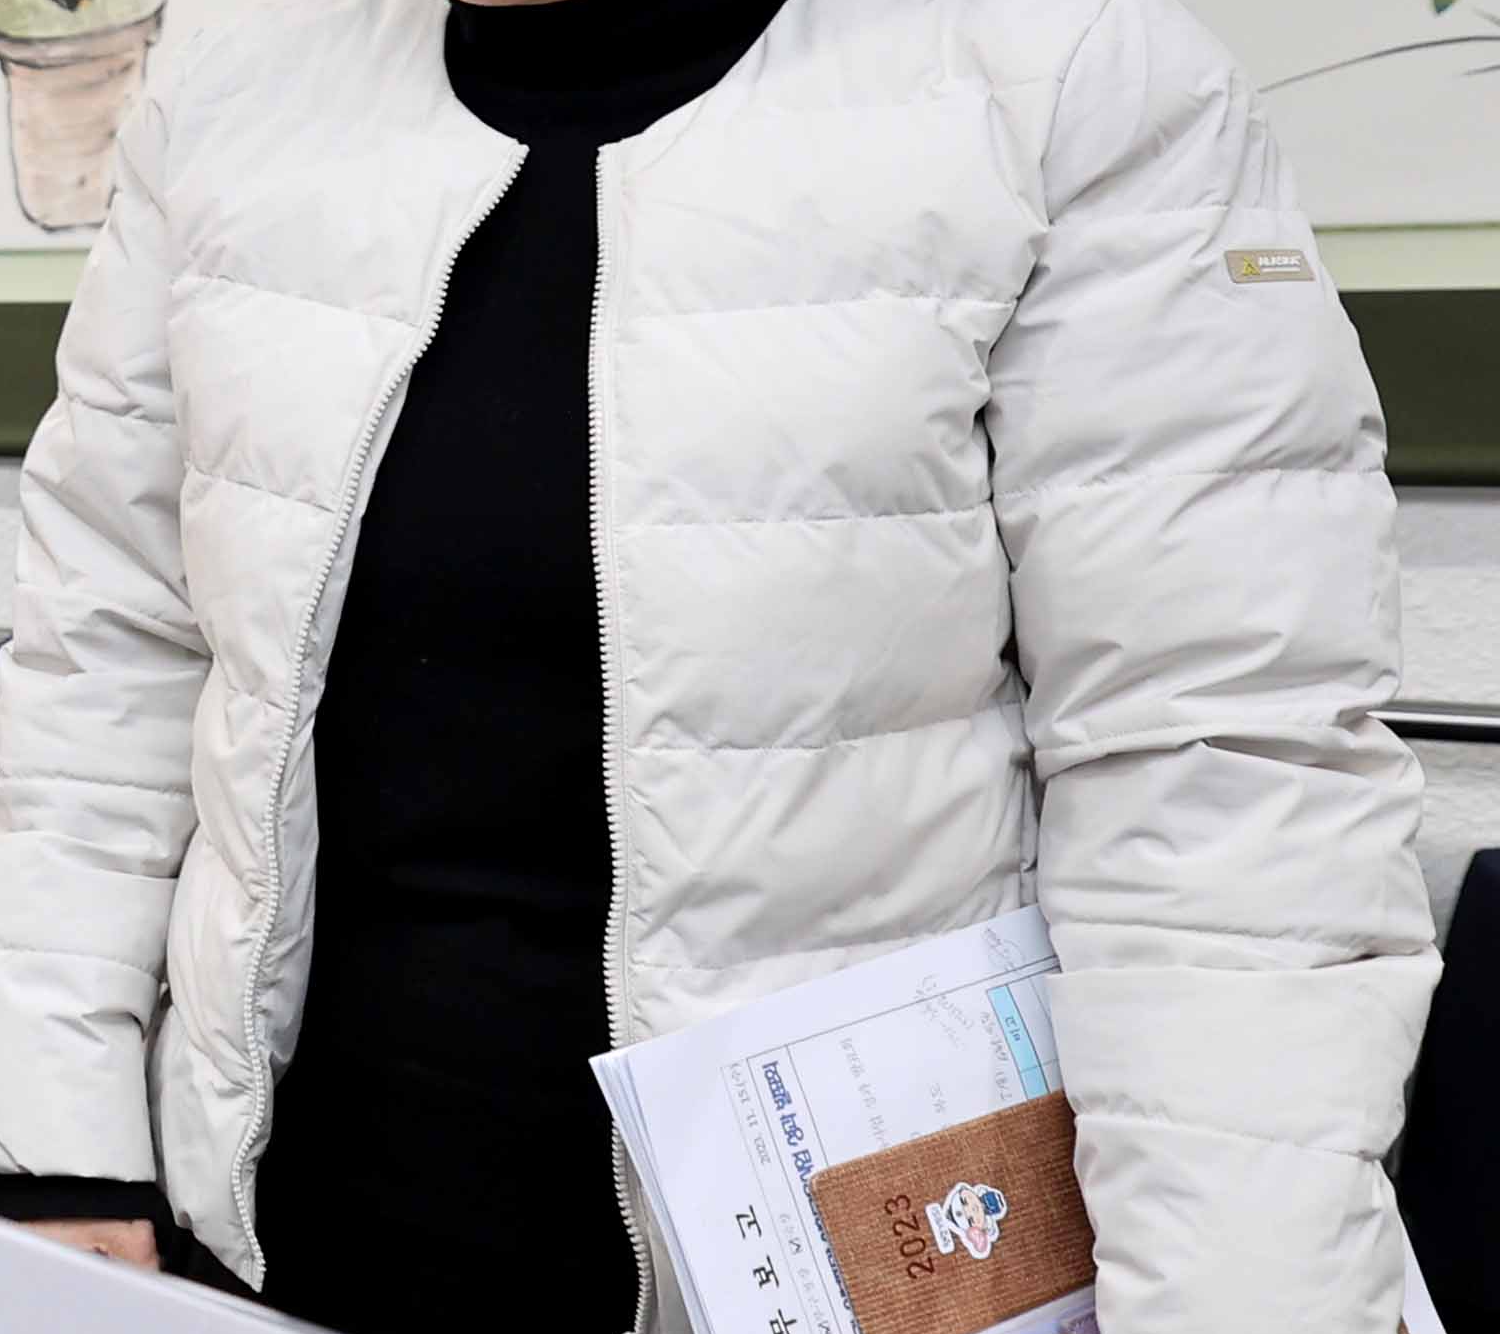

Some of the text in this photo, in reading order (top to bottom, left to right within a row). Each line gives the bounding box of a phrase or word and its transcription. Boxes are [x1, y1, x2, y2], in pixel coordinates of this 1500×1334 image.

[761, 1060, 792, 1110] 발표회
[779, 1111, 805, 1147] 성과
[885, 1194, 936, 1281] 2023
